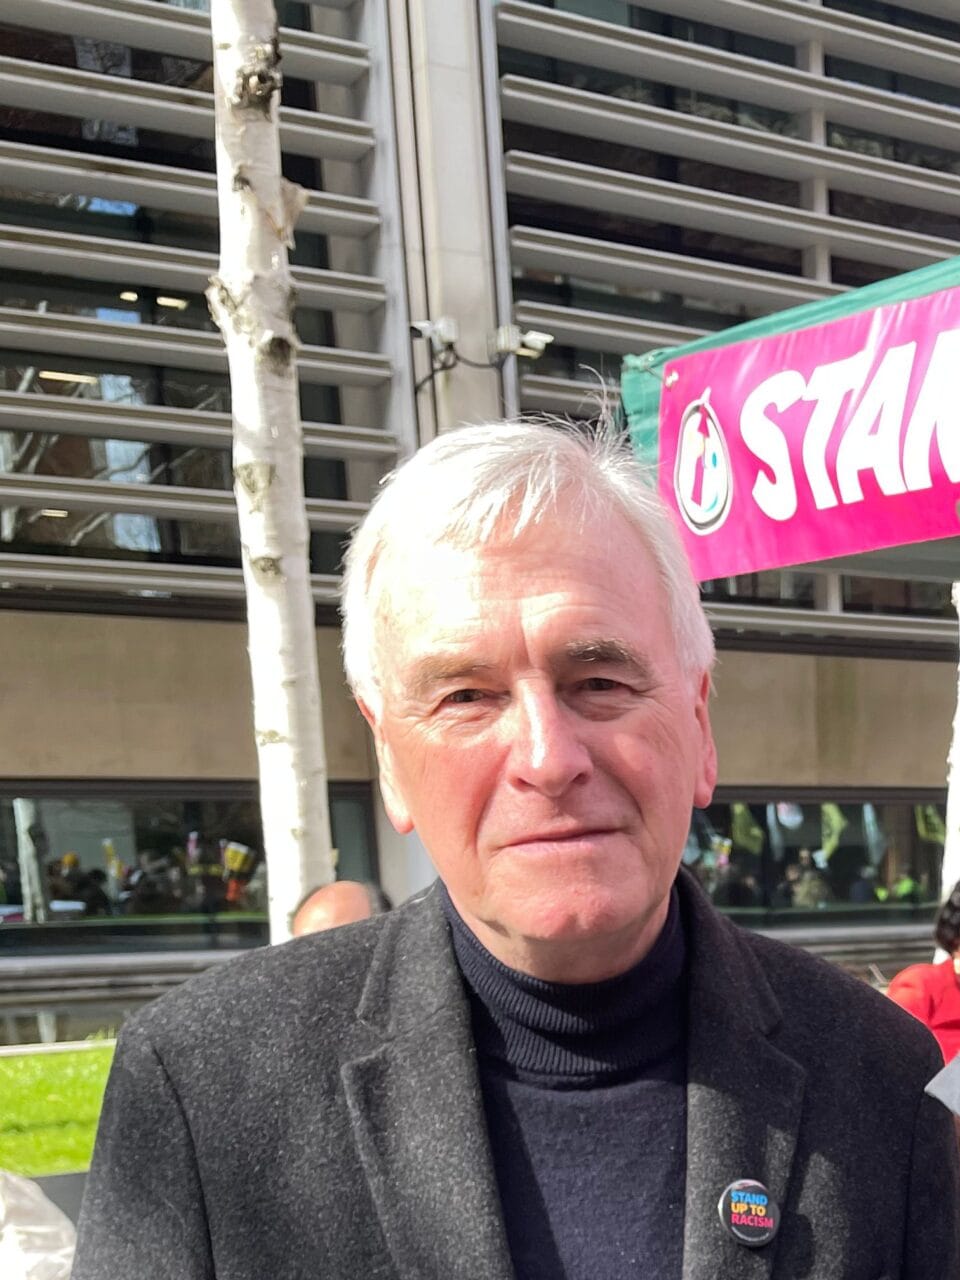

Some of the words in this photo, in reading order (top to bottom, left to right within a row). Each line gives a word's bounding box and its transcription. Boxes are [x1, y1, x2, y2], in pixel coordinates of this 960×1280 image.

[731, 1191, 768, 1205] STAND
[731, 1203, 747, 1213] UP
[750, 1205, 766, 1216] TO
[731, 1214, 773, 1228] RACISM
